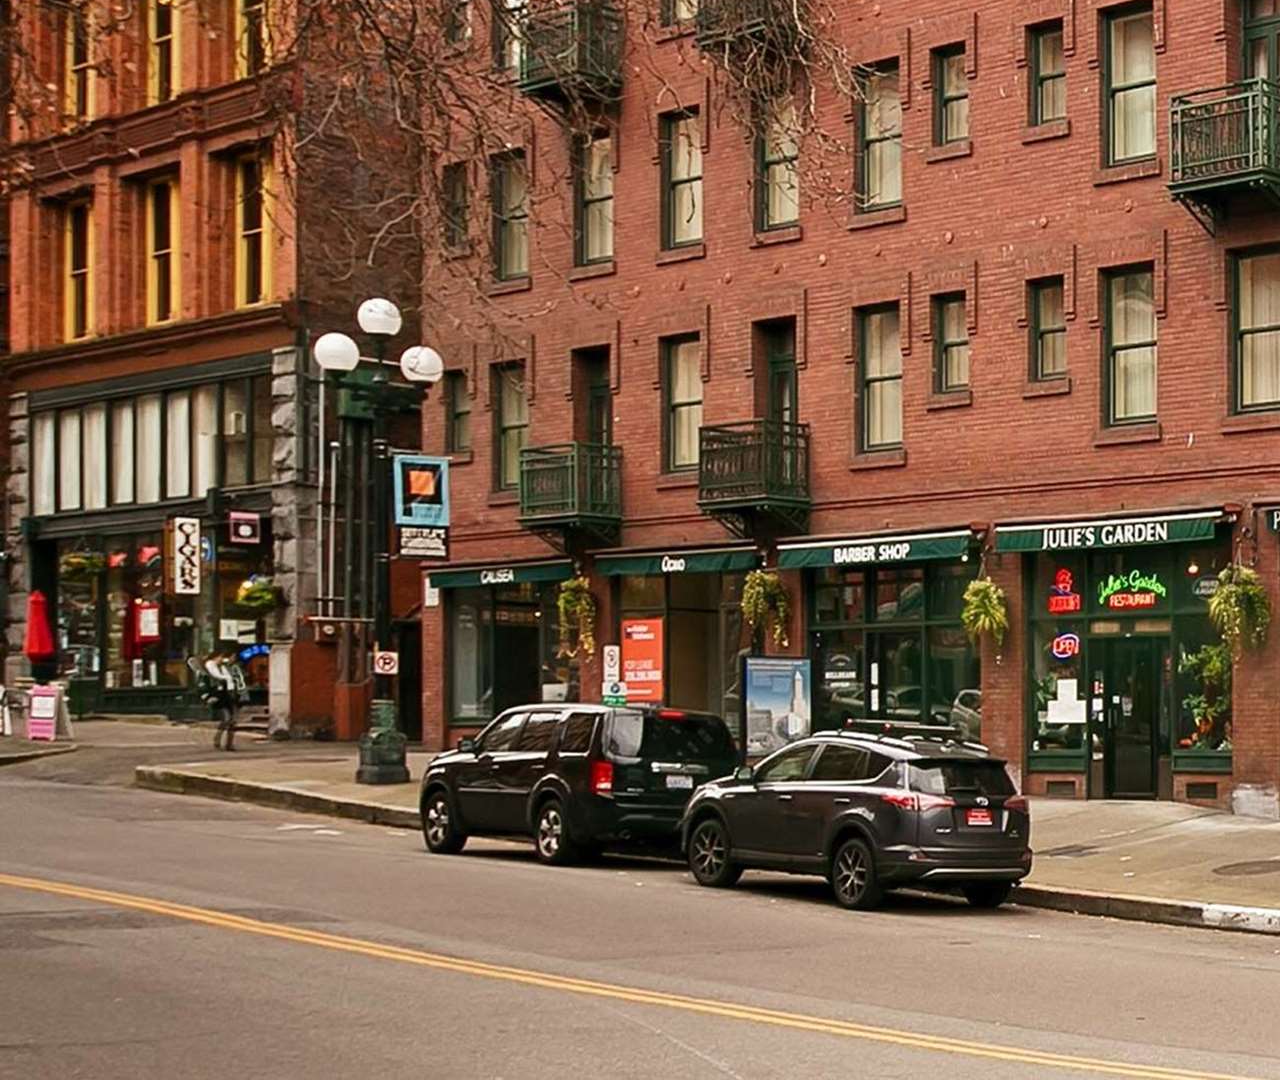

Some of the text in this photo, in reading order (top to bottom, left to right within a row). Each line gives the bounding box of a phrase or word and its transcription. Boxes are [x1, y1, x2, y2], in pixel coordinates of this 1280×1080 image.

[1042, 522, 1168, 549] JULIE'S GARDEN
[834, 543, 910, 563] BARBER SHOP
